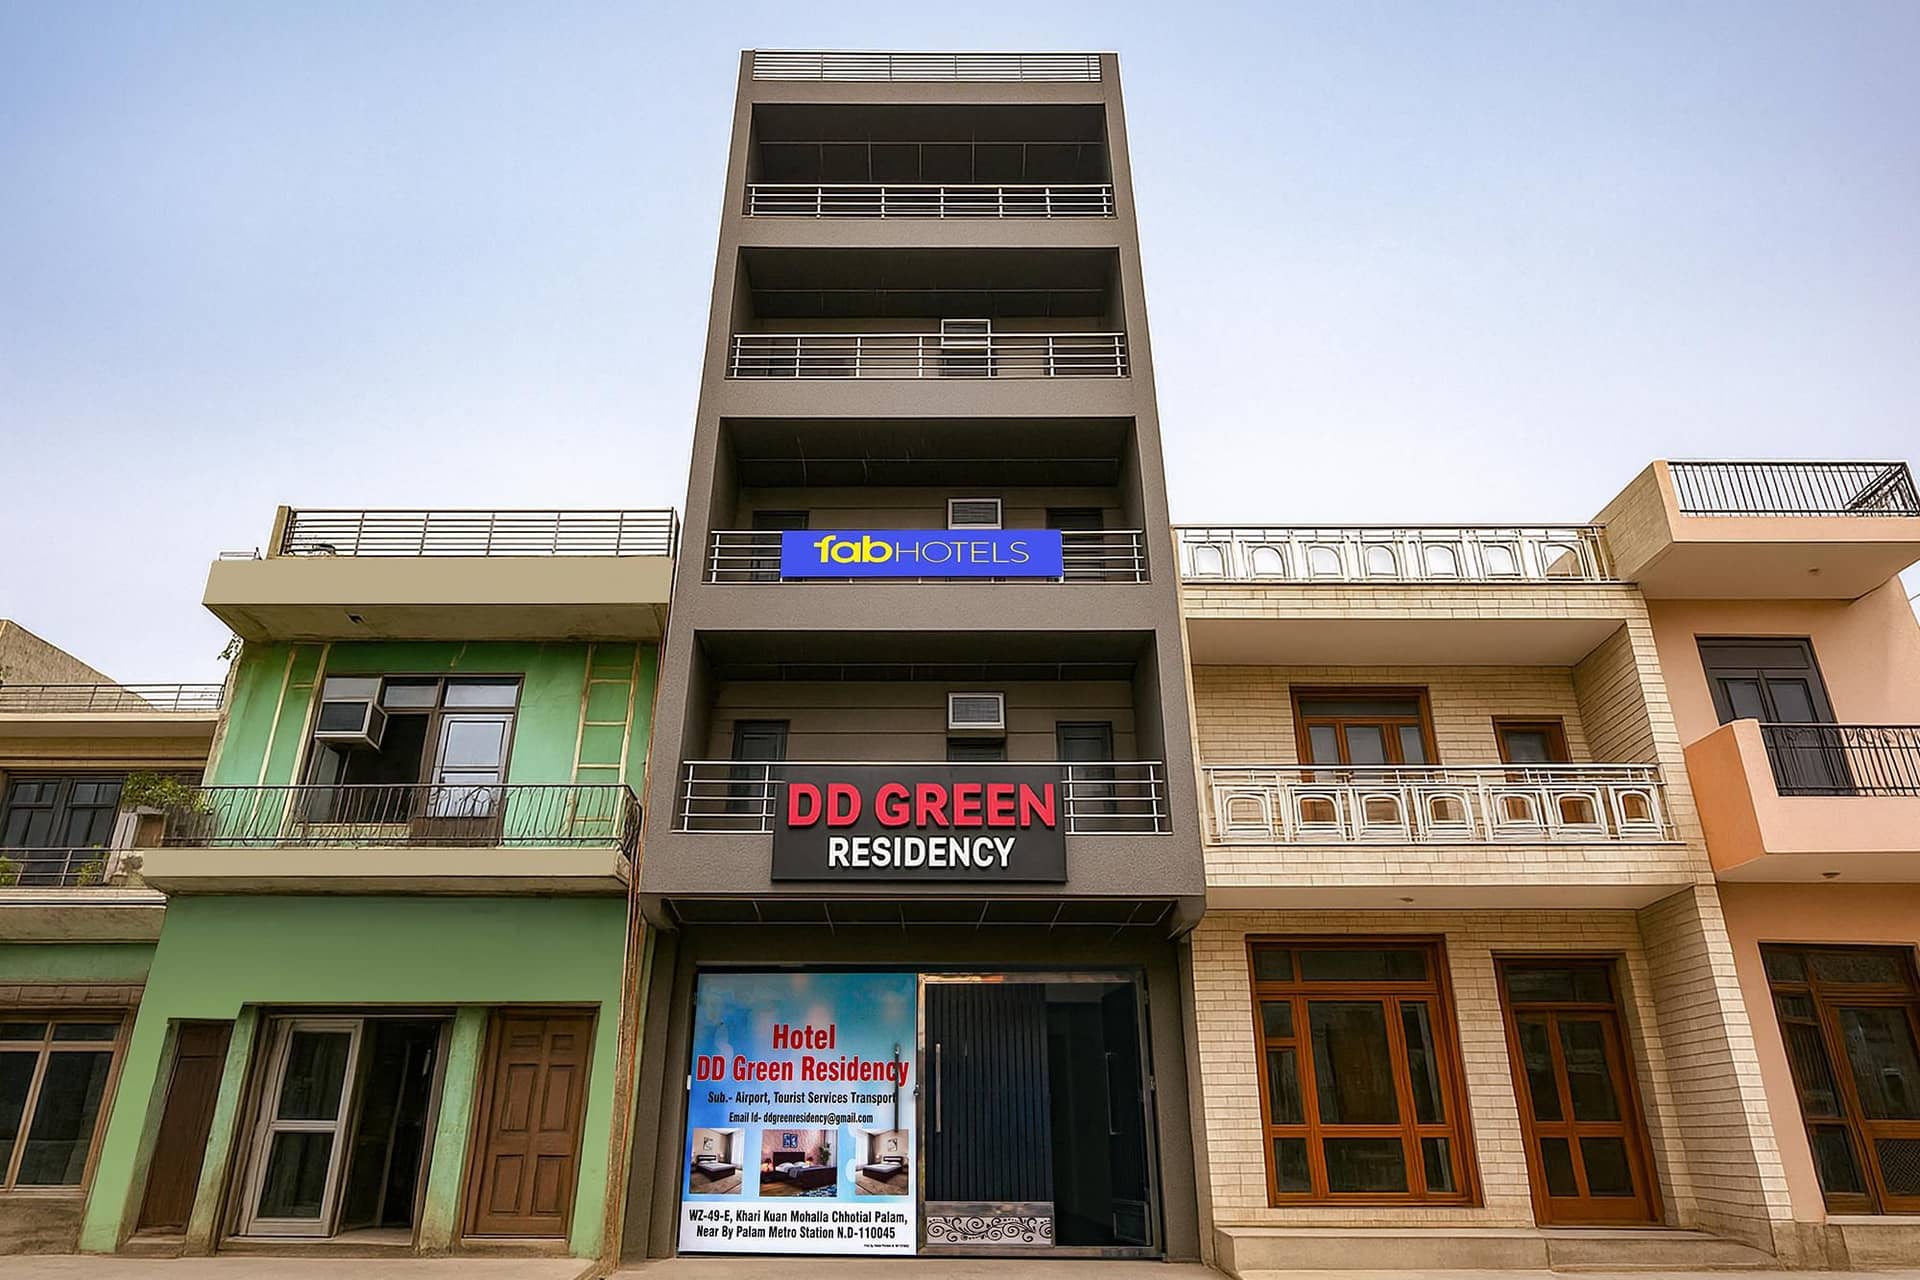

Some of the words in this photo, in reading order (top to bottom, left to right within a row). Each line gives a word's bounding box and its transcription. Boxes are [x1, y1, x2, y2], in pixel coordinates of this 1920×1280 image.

[813, 535, 1030, 564] fabHOTELS
[787, 783, 862, 827] DD
[875, 783, 1056, 828] GREEN
[828, 837, 1015, 868] RESIDENCY
[773, 1024, 836, 1049] Hotel
[696, 1056, 725, 1081] DD
[733, 1056, 793, 1081] Green
[802, 1056, 909, 1087] Residency
[735, 1092, 770, 1105] Airport,
[774, 1092, 805, 1103] Tourist
[808, 1092, 848, 1104] Services
[851, 1092, 896, 1105] Transport
[729, 1112, 749, 1123] Email
[764, 1112, 873, 1125] ddgreenresidency@gmail.com
[689, 1210, 732, 1223] WZ-49-E,
[736, 1210, 761, 1222] Khari
[764, 1211, 787, 1222] Kuan
[790, 1211, 828, 1222] Mohalla
[832, 1211, 872, 1223] Chhotial
[875, 1212, 908, 1225] Palam,
[697, 1226, 719, 1237] Near
[722, 1226, 733, 1240] By
[737, 1227, 765, 1238] Palam
[769, 1227, 797, 1238] Metro
[800, 1227, 833, 1238] Station
[837, 1227, 895, 1239] N.D-110045
